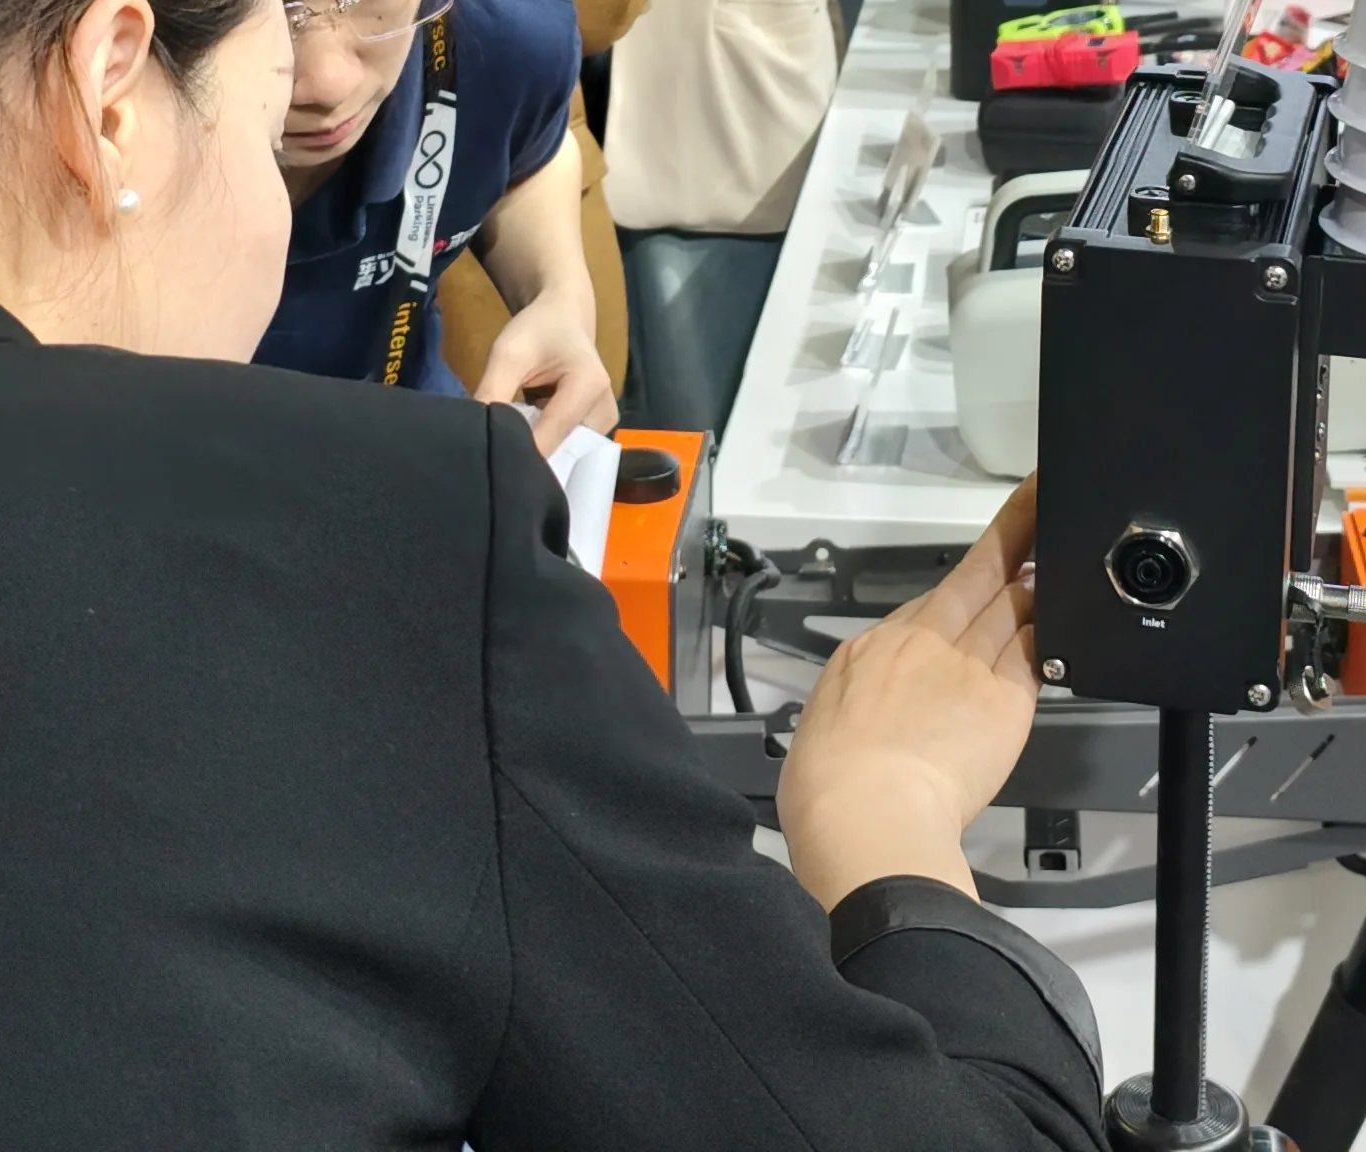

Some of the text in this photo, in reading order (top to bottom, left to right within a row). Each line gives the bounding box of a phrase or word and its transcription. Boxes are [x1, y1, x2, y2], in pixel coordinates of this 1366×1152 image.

[432, 14, 446, 72] rsec
[408, 194, 424, 243] Parking
[383, 301, 418, 386] interse
[1142, 616, 1166, 629] Inlet
